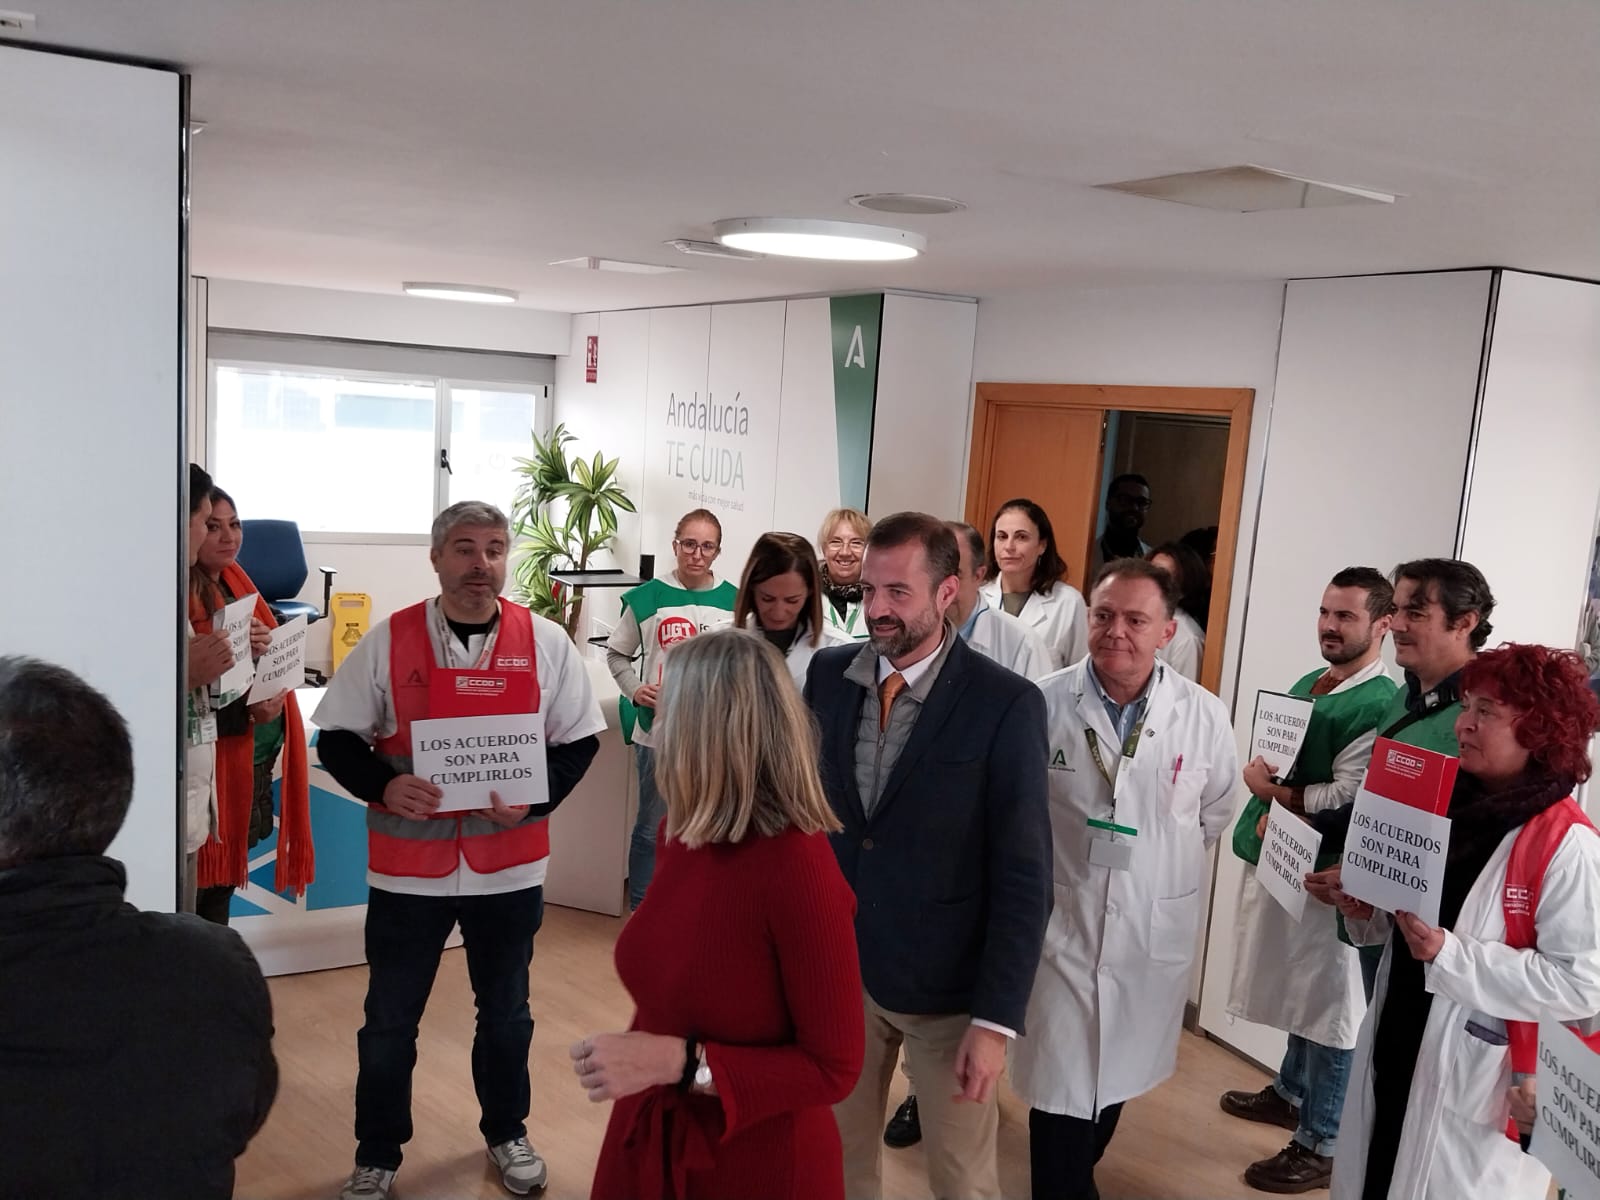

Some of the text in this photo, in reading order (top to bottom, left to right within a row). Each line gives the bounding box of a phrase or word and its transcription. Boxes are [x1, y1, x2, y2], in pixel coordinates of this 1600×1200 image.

[666, 391, 749, 436] Andalucía
[666, 440, 745, 490] TE CUIDA
[661, 622, 692, 641] UGT
[497, 658, 529, 667] CCOO
[468, 679, 495, 687] CCOO
[1259, 709, 1307, 729] LOS ACUERDOS
[420, 732, 538, 752] LOS ACUERDOS
[1257, 738, 1297, 757] CUMPLIRLOS
[1266, 726, 1297, 742] SON PARA
[444, 751, 520, 767] SON PARA
[1395, 755, 1416, 767] CCOO
[430, 767, 533, 785] CUMPLIRLOS
[1277, 828, 1312, 863] ACUERDOS
[1352, 811, 1441, 854] LOS ACUERDOS
[1271, 839, 1300, 873] SON PARA
[1360, 835, 1421, 869] SON PARA
[1265, 850, 1302, 893] CUMPLIRLOS
[1347, 851, 1429, 893] CUMPLIRLOS
[1539, 1041, 1559, 1075] LOS
[1553, 1086, 1577, 1123] SON
